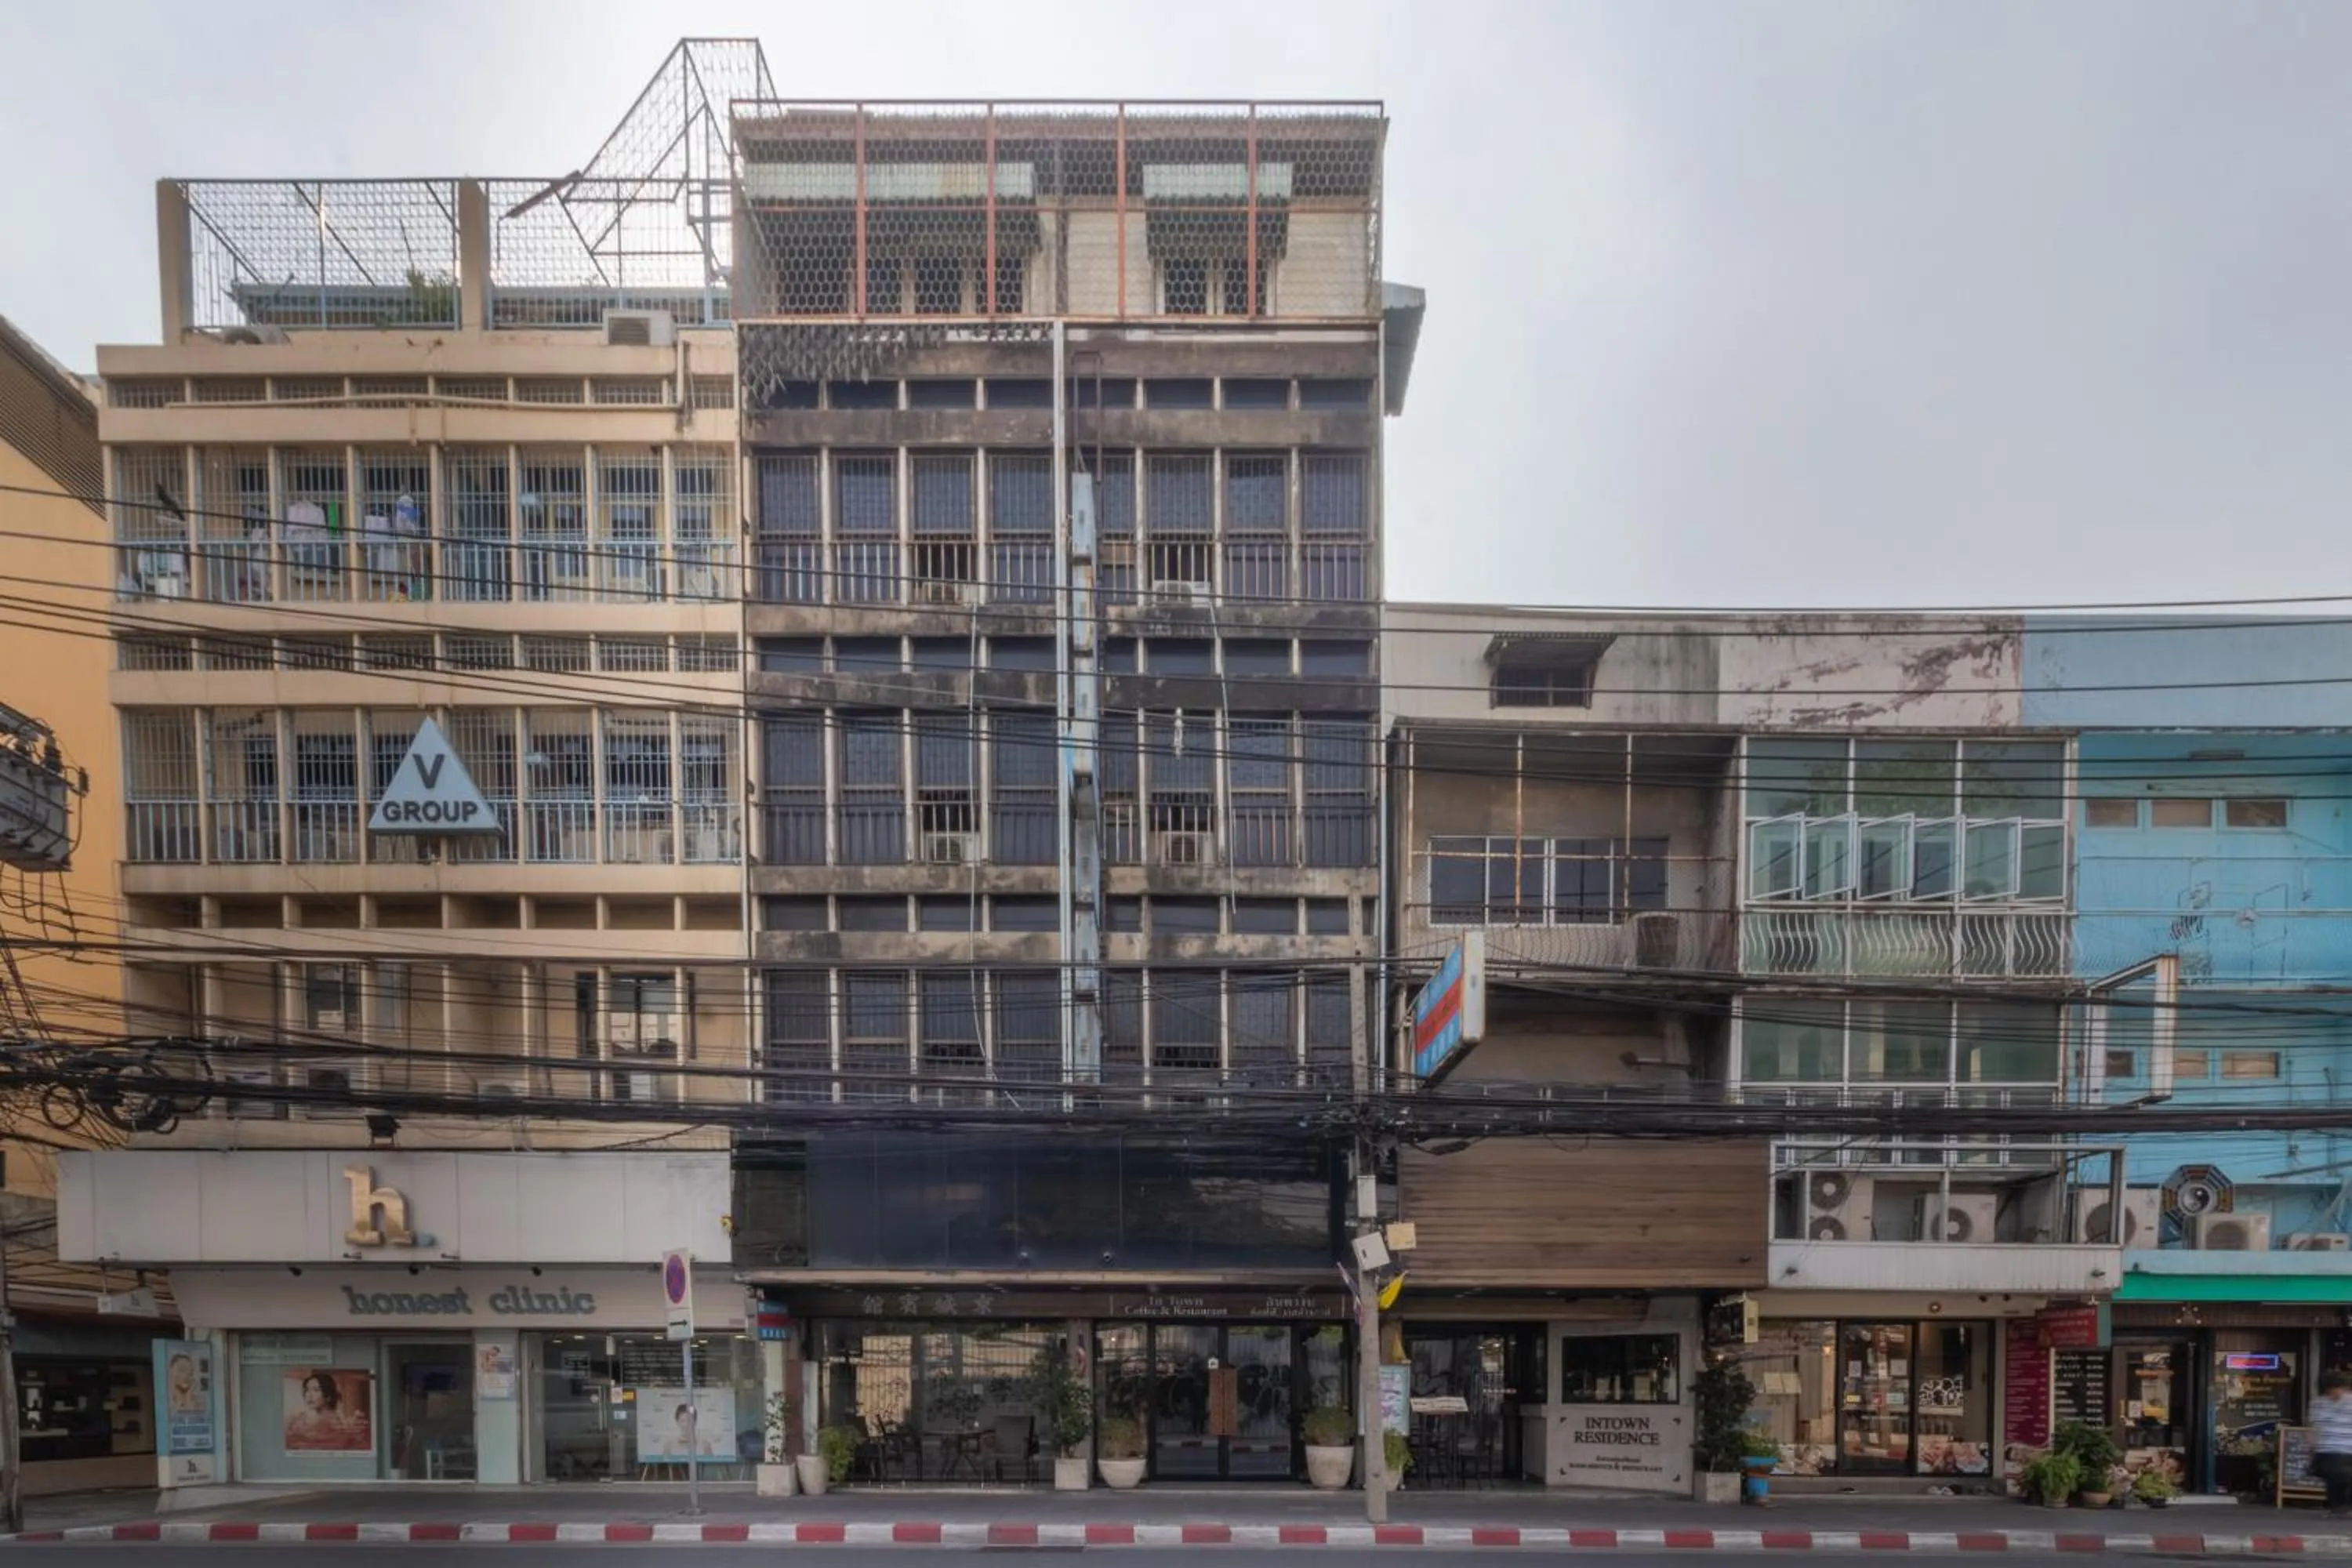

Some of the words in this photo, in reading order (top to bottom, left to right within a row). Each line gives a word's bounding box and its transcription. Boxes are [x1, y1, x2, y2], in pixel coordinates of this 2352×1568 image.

[412, 753, 446, 789] V
[382, 800, 478, 822] GROUP
[340, 1284, 473, 1315] honest
[488, 1284, 597, 1315] clinic
[1584, 1417, 1650, 1430] INTOWN
[1573, 1432, 1661, 1446] RESIDENCE
